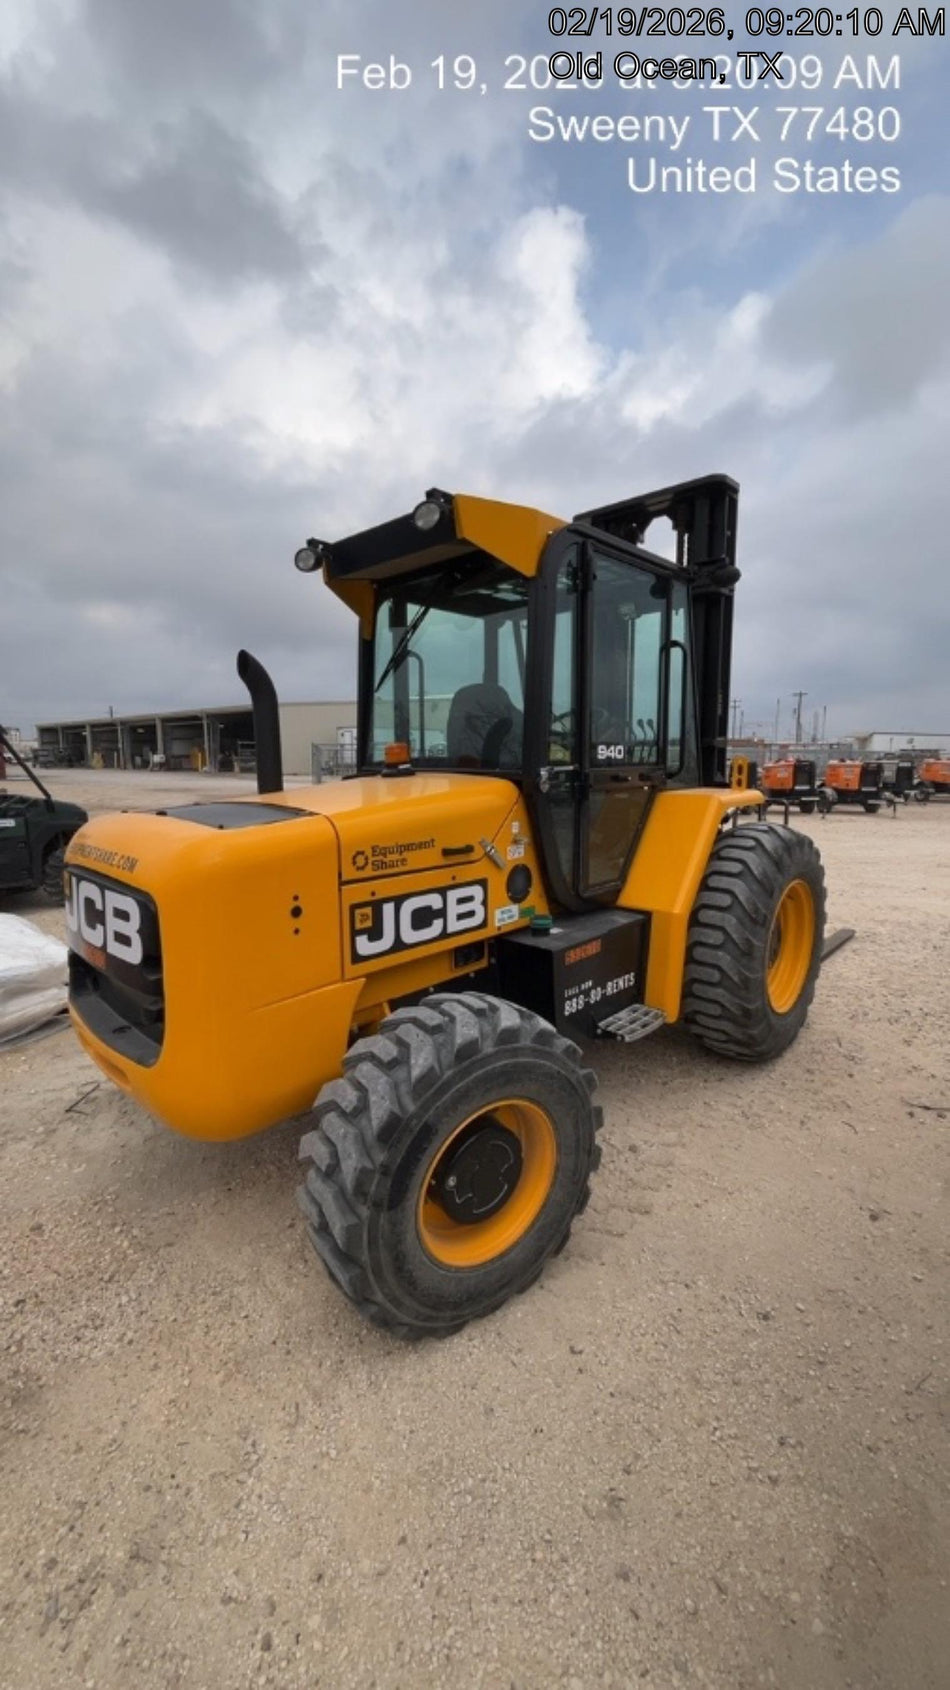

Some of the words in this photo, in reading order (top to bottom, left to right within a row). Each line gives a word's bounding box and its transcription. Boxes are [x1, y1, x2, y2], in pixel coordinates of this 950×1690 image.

[596, 745, 625, 760] 940
[370, 838, 436, 857] Equipment
[370, 857, 408, 872] Share
[354, 884, 486, 958] JCB
